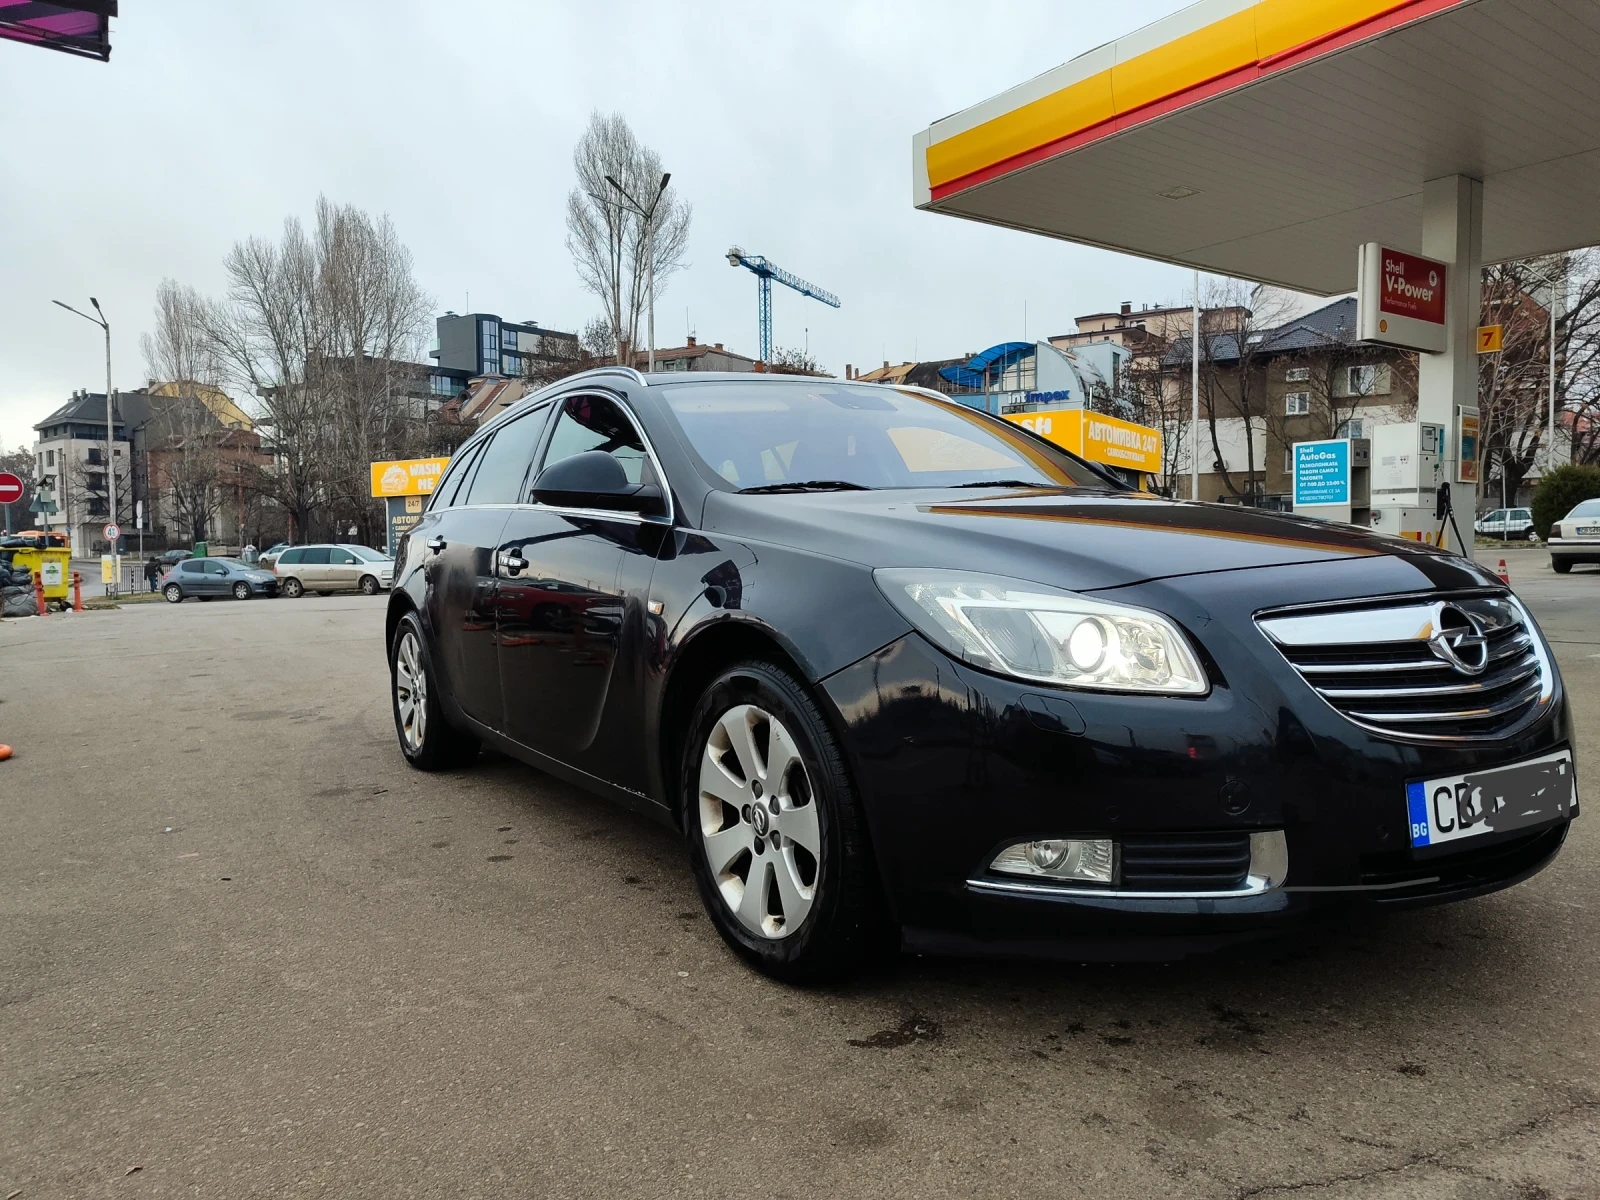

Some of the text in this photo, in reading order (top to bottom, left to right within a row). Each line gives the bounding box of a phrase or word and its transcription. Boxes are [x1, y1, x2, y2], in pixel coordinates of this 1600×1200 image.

[1386, 259, 1404, 276] Shell
[1386, 274, 1434, 302] V-Power
[1482, 332, 1494, 346] 7
[1007, 390, 1070, 404] intimpex
[1088, 420, 1158, 454] АВТОМИВКА 24/7
[1300, 452, 1336, 460] AutoGas
[410, 462, 441, 476] WASH
[418, 478, 434, 490] ME
[1412, 823, 1428, 838] BG
